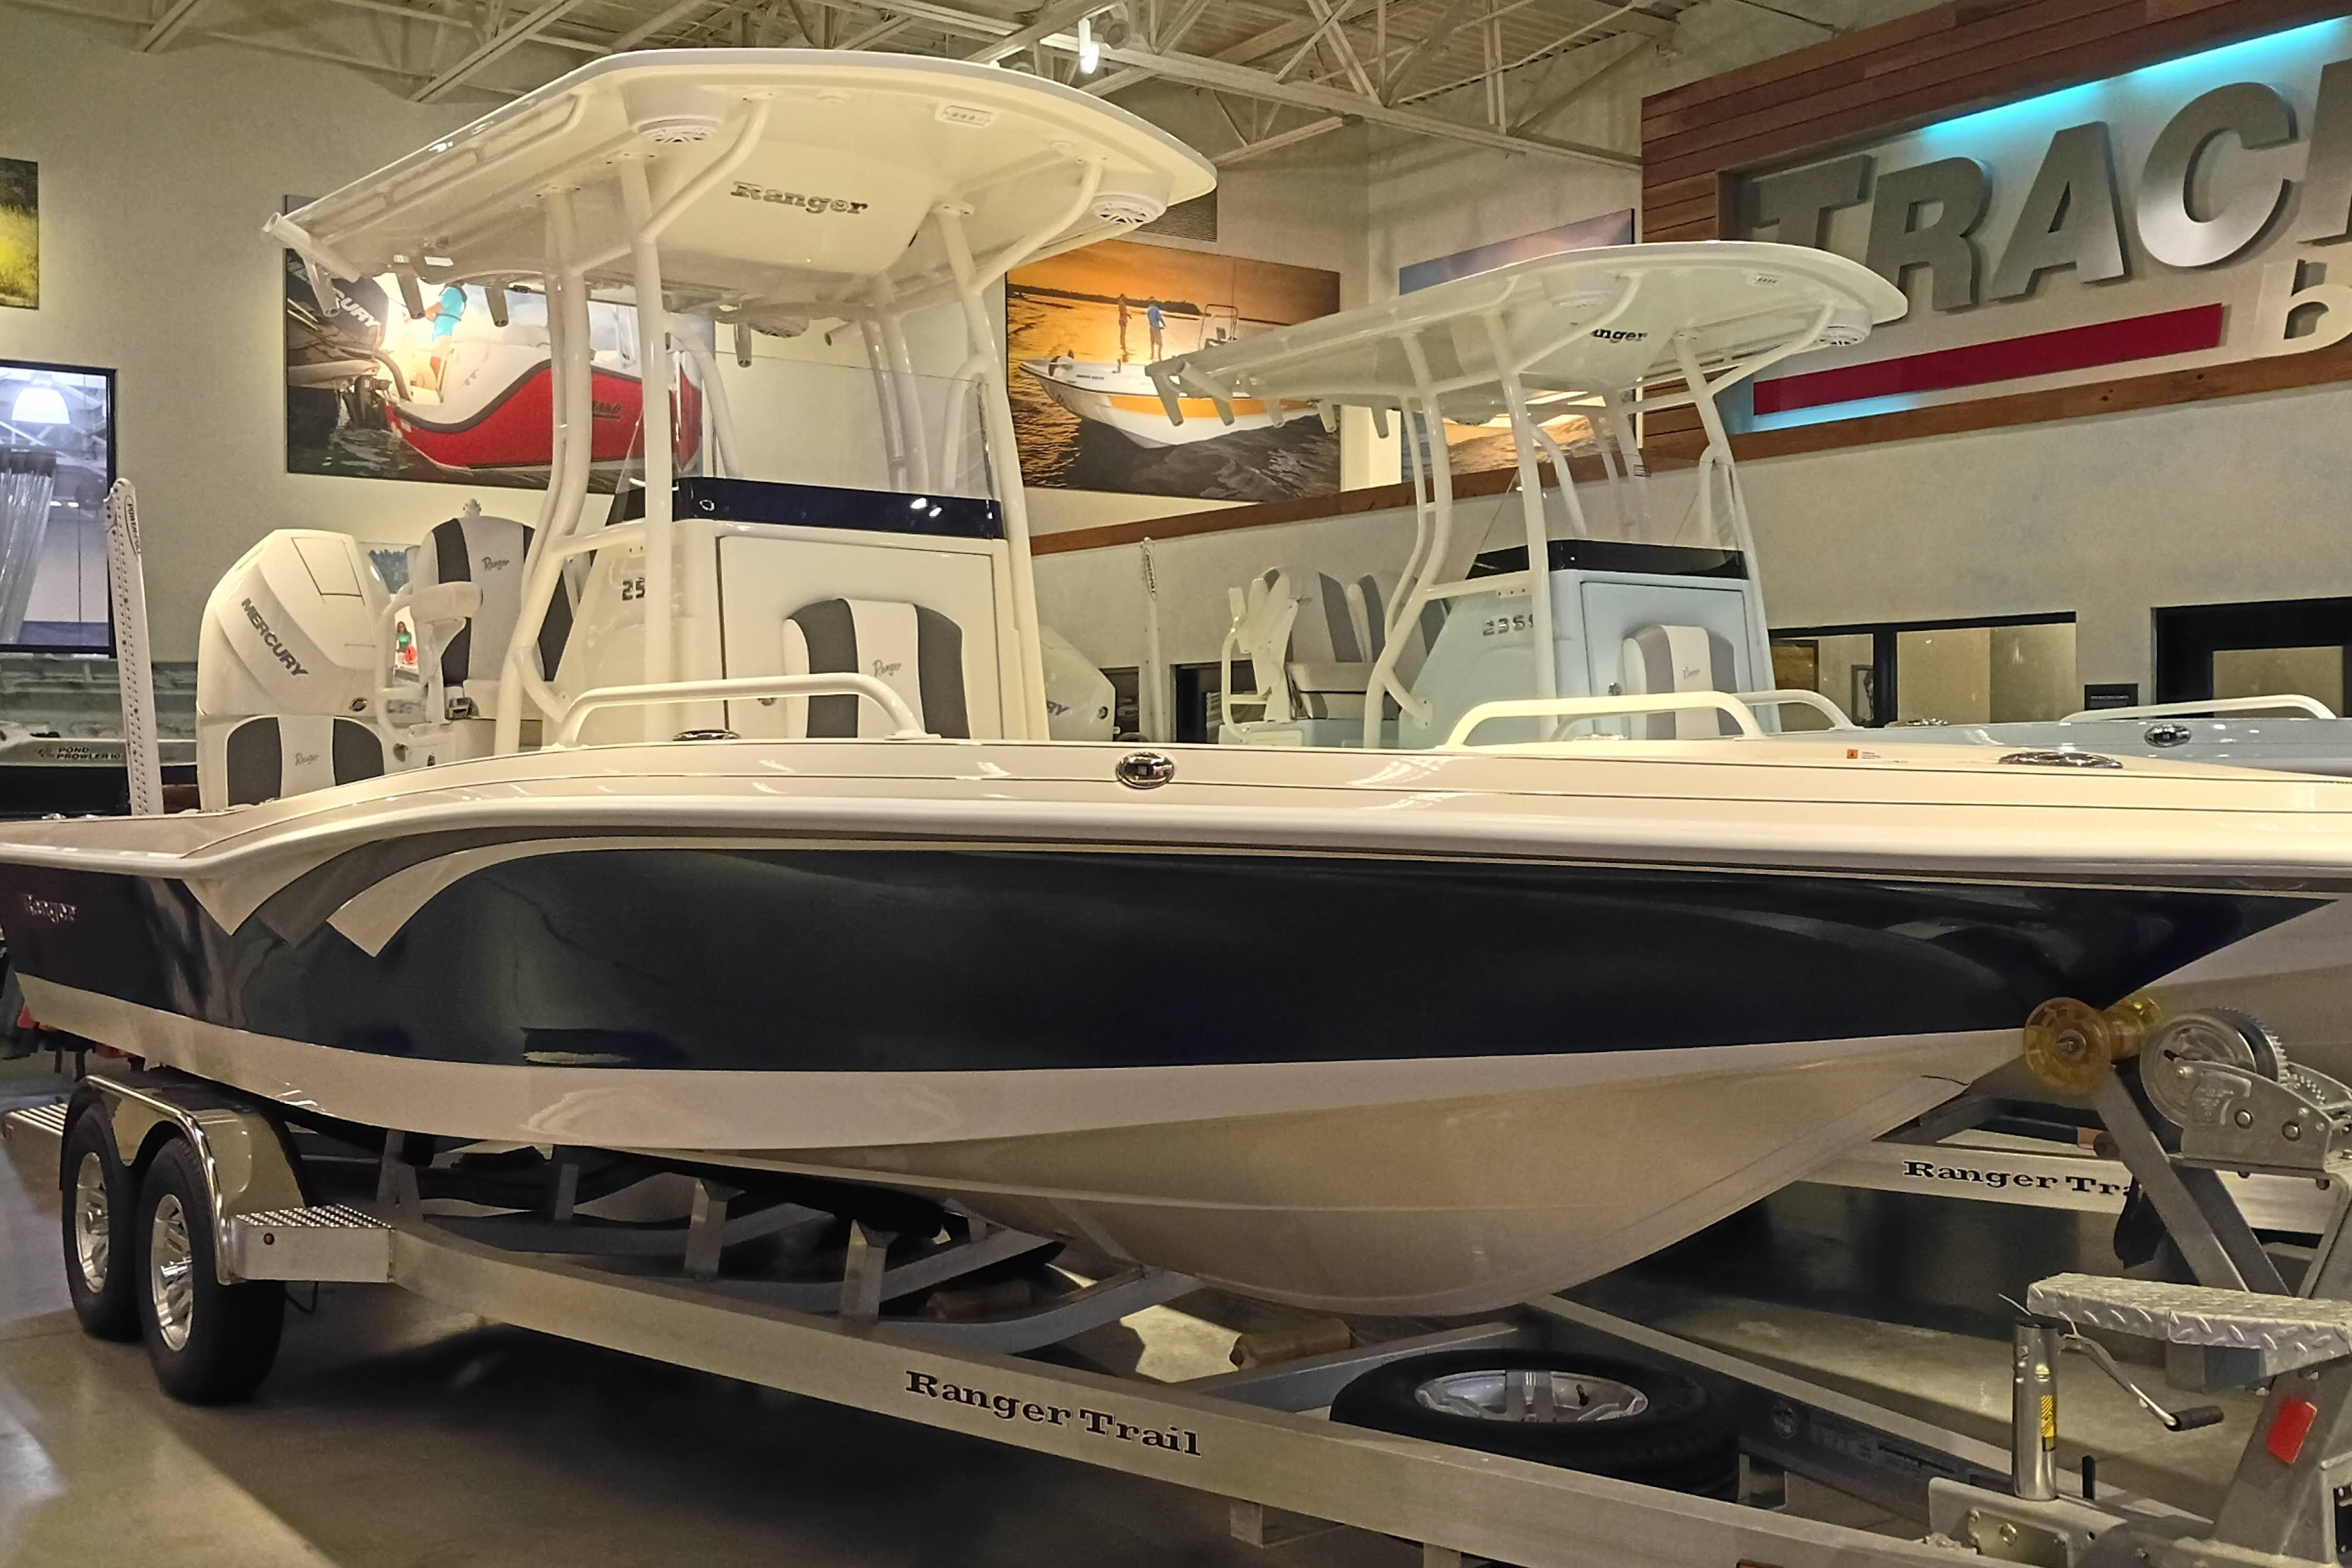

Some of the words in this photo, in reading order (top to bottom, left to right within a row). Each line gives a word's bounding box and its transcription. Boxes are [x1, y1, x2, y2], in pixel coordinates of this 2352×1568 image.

[730, 180, 869, 214] Ranger
[241, 597, 309, 676] MERCURY
[1903, 1160, 2058, 1189] Ranger
[905, 1369, 1071, 1425] Ranger
[1079, 1408, 1202, 1457] Trail
